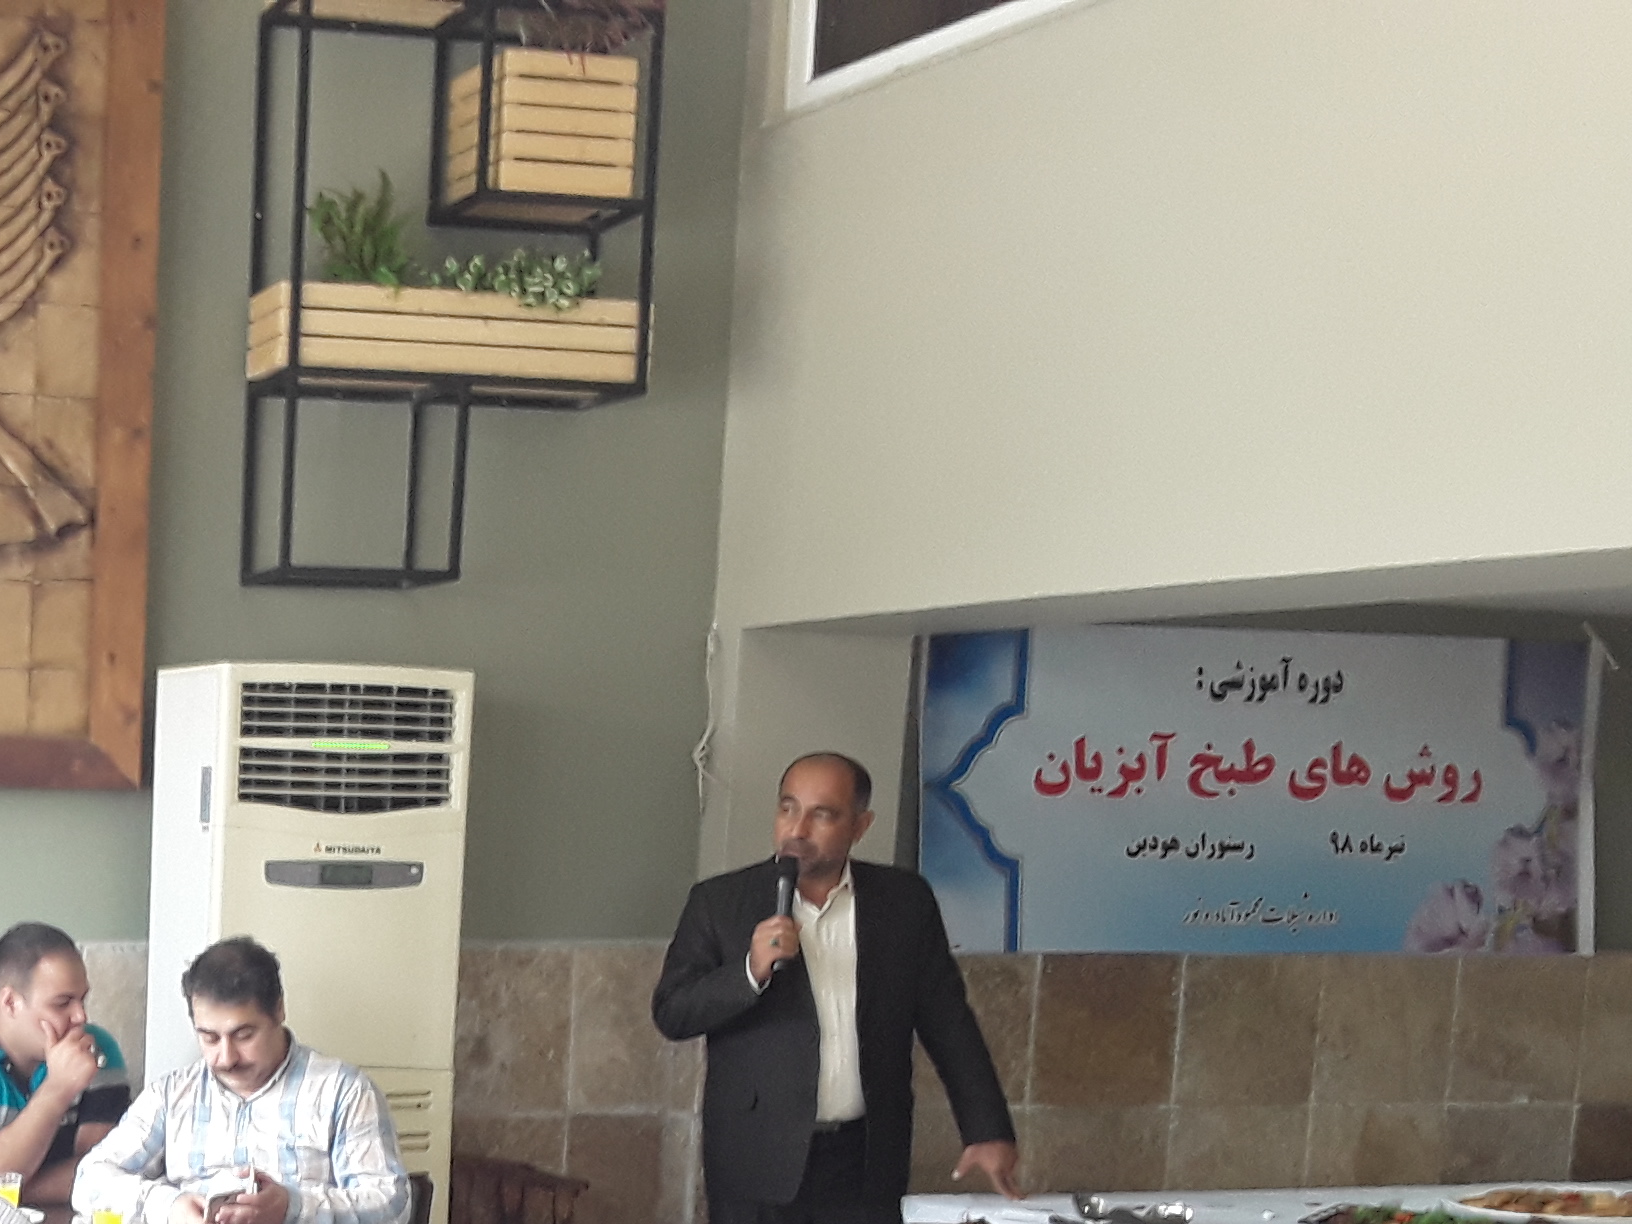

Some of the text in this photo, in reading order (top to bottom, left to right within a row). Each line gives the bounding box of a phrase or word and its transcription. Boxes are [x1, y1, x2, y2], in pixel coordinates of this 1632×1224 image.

[1297, 668, 1344, 704] دوره
[1033, 731, 1484, 804] روش های طبخ آبزیان
[1329, 830, 1352, 854] ۹۸
